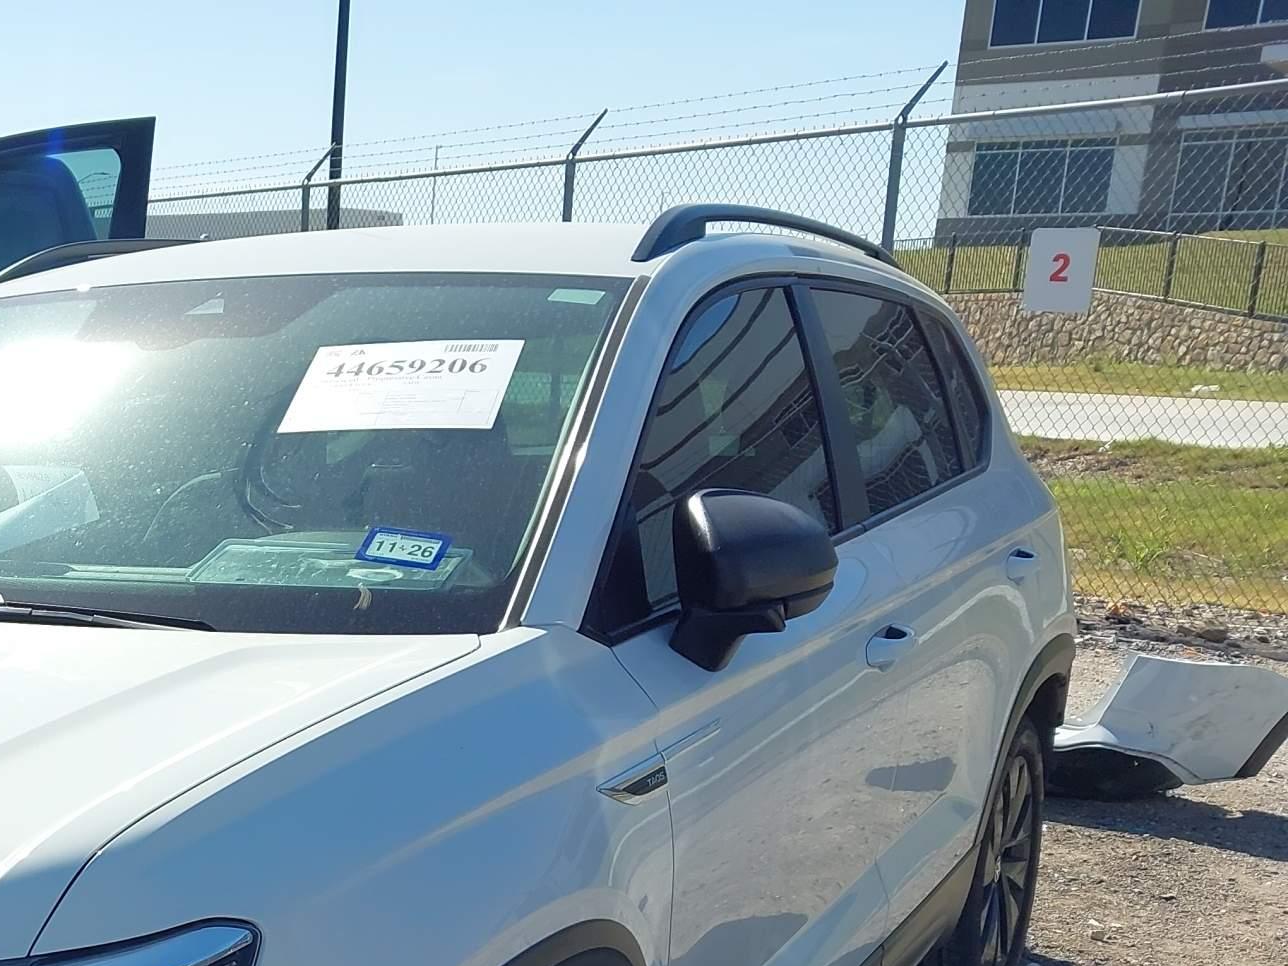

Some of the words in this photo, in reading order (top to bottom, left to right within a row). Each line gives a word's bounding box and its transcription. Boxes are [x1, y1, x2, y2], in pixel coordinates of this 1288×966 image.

[1049, 252, 1071, 282] 2
[326, 357, 491, 378] 44659206
[375, 540, 399, 553] 11
[407, 543, 435, 559] 26
[646, 771, 665, 787] TAOS
